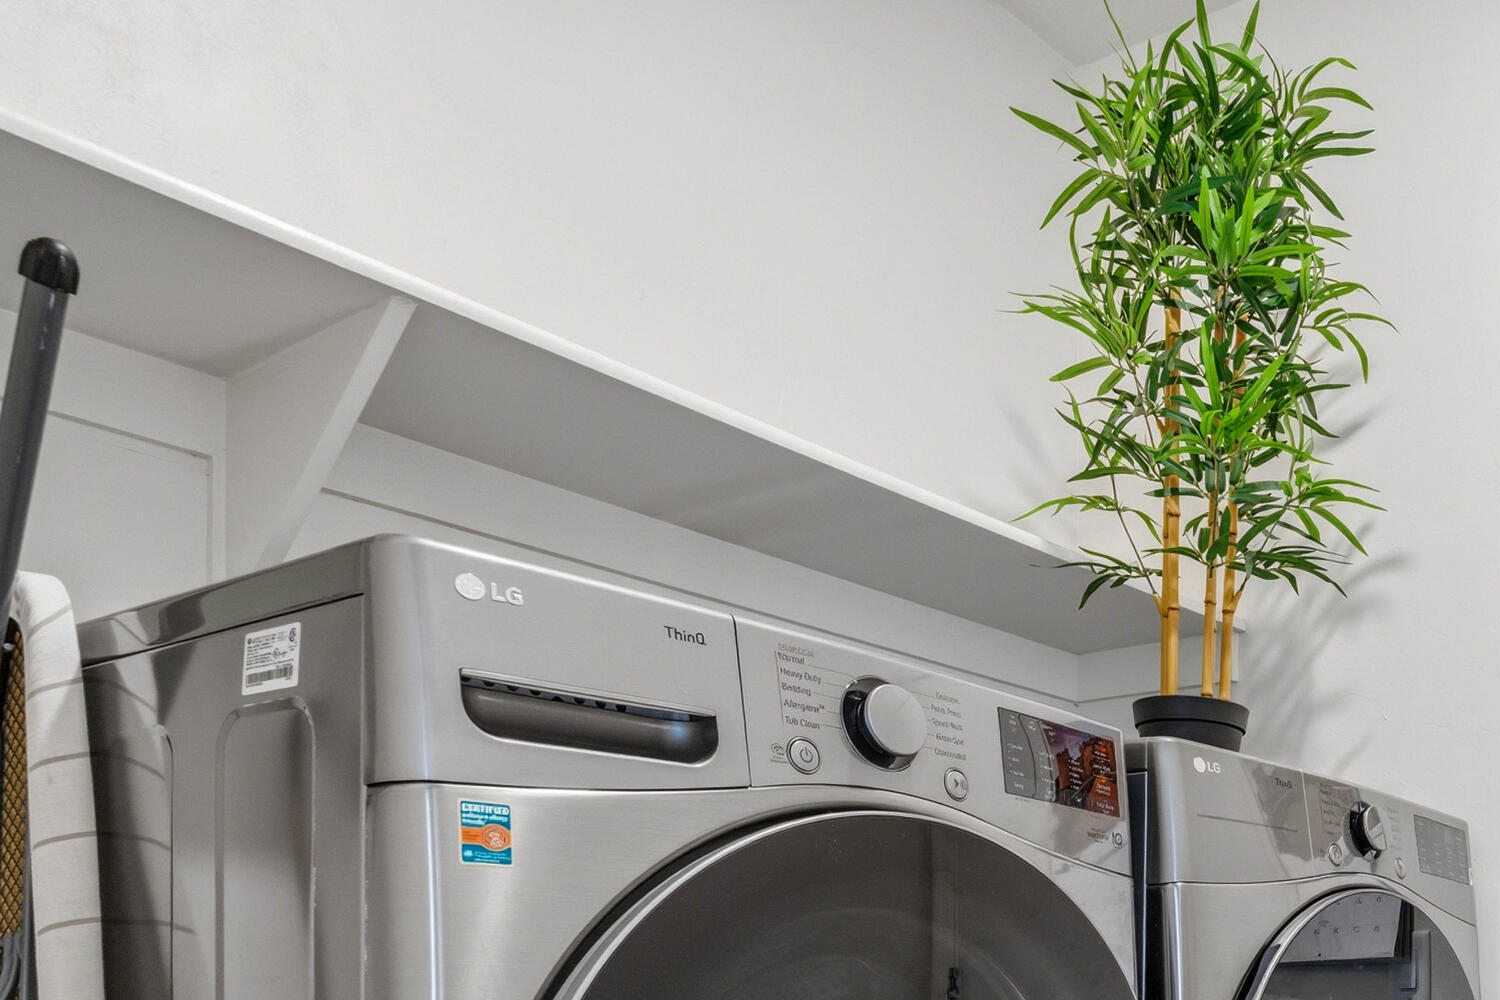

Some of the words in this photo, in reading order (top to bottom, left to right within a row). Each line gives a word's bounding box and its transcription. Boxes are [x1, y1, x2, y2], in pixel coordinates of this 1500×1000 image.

[490, 582, 524, 605] LG
[664, 625, 708, 646] ThinQ
[1206, 761, 1222, 774] LG
